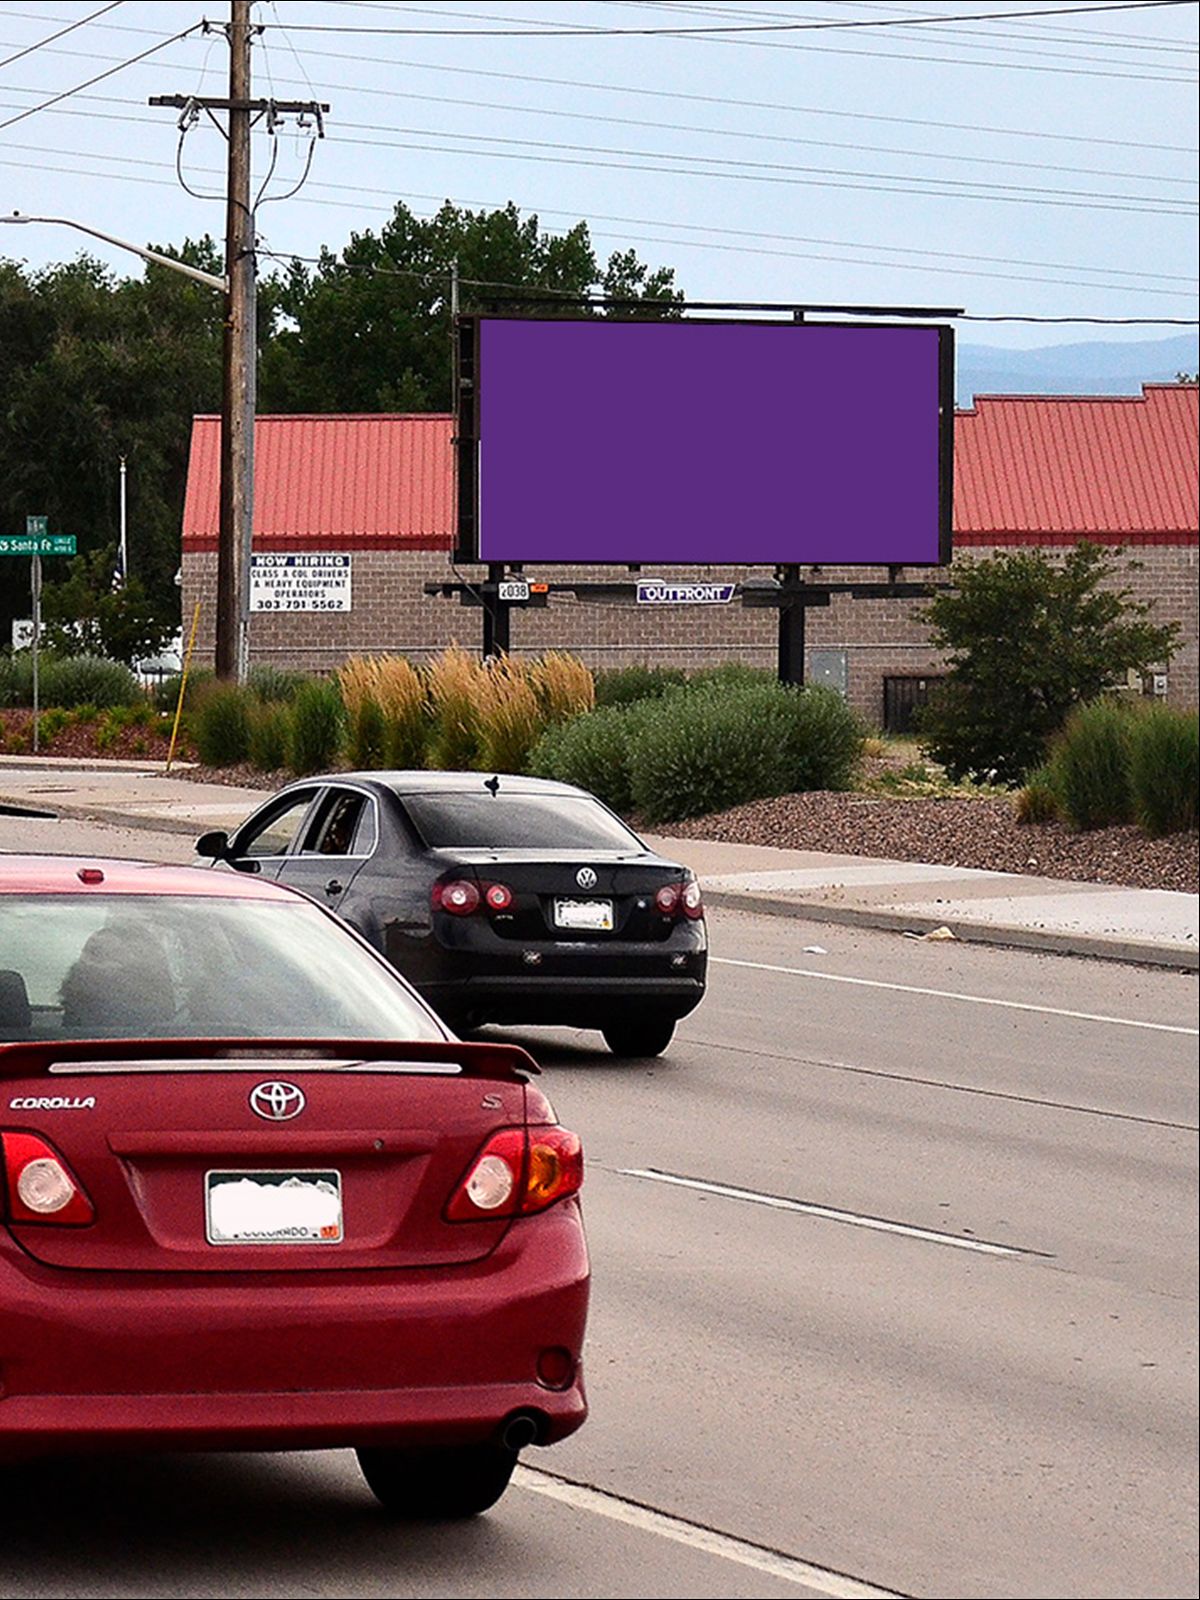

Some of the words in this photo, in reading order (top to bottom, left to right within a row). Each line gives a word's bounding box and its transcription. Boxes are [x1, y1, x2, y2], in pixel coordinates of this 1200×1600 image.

[11, 540, 38, 551] Santa
[40, 539, 52, 551] Fe
[256, 556, 288, 567] NOW
[294, 556, 344, 567] HIRING
[251, 570, 279, 578] CLASS
[282, 570, 289, 578] A
[311, 570, 349, 578] DRIVERS
[264, 580, 292, 588] HEAVY
[296, 580, 346, 588] EQUIPMENT
[274, 590, 326, 598] OPERATORS
[645, 587, 725, 600] OUTFRONT
[9, 1096, 96, 1110] COROLLA
[481, 1094, 503, 1110] S
